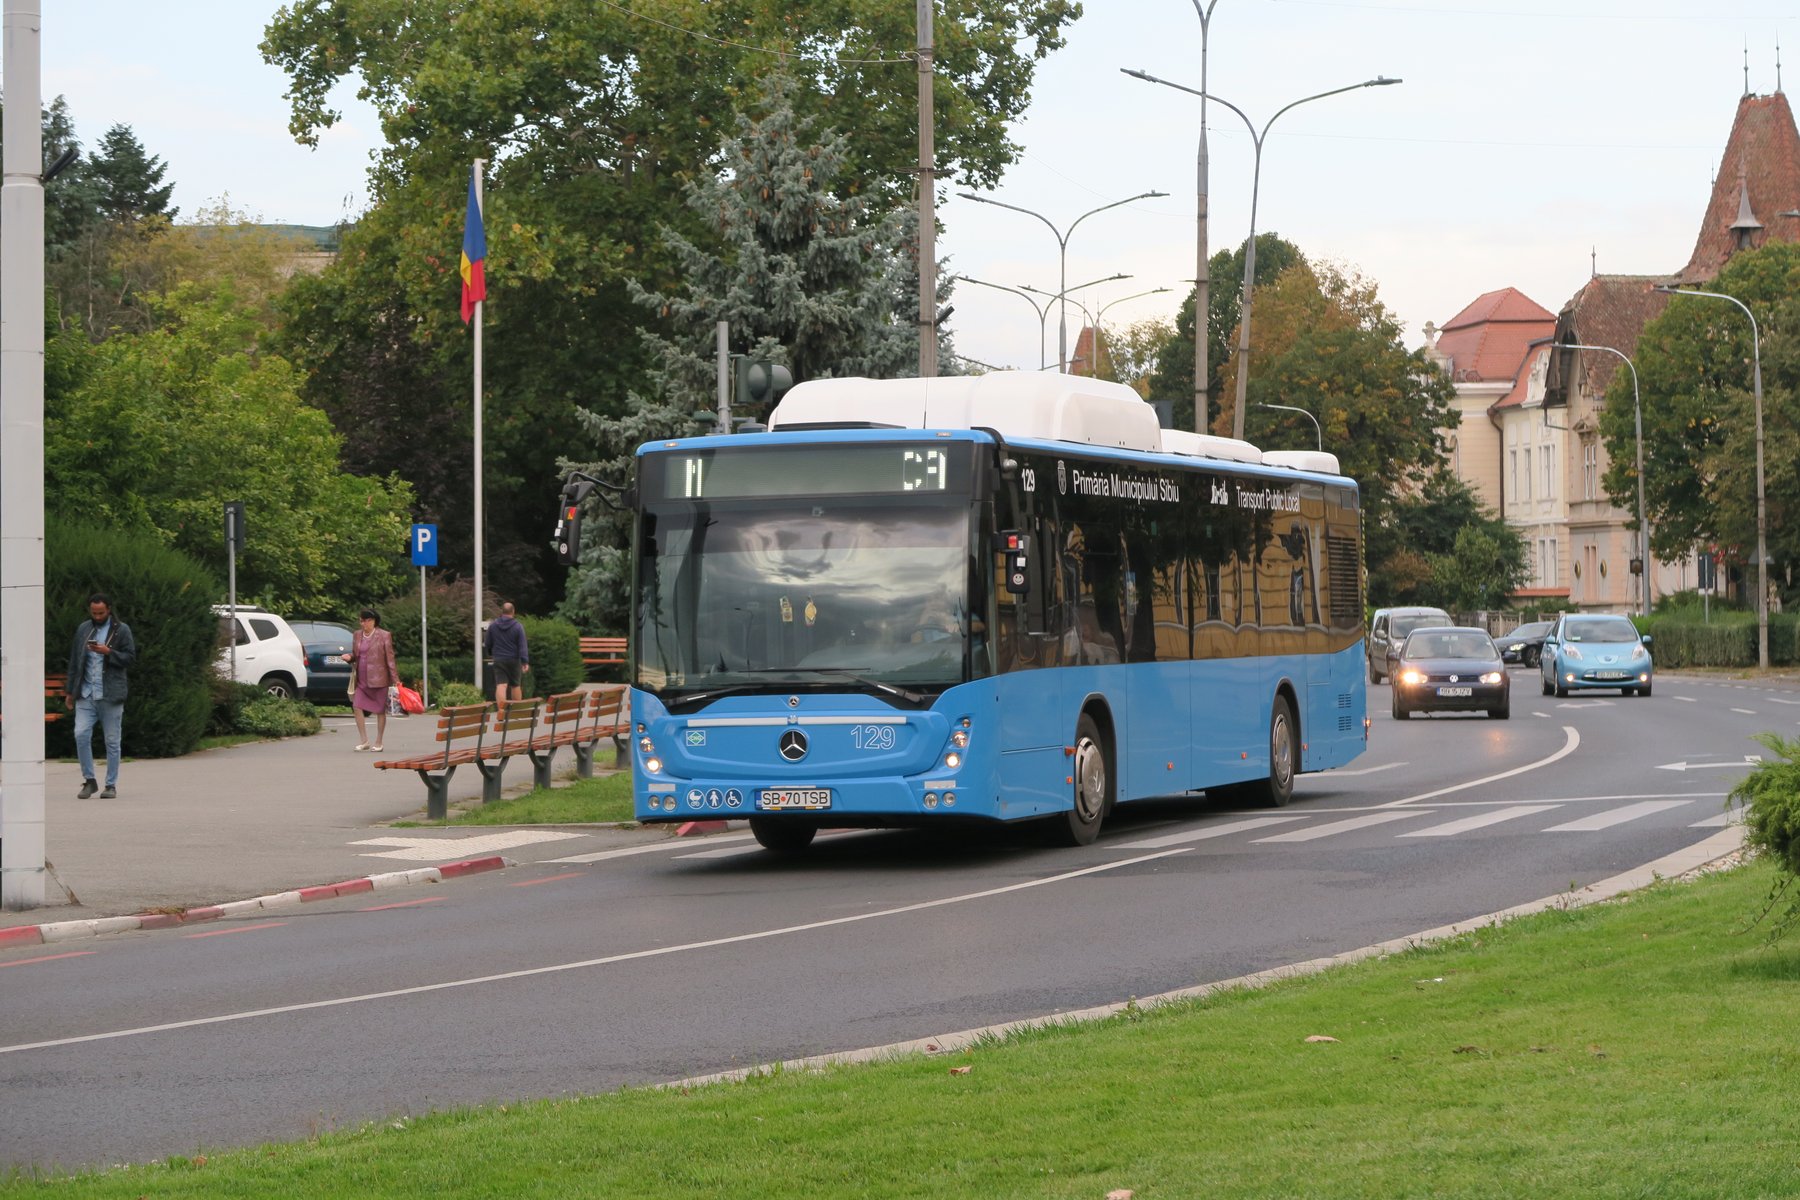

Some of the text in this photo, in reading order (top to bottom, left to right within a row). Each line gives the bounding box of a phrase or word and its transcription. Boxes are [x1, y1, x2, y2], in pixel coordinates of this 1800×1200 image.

[1021, 468, 1036, 492] 129
[1072, 469, 1180, 505] Primăria Municipiului Sibiu
[1236, 485, 1300, 514] Transport Public Local
[417, 528, 432, 553] P
[850, 724, 896, 750] 129
